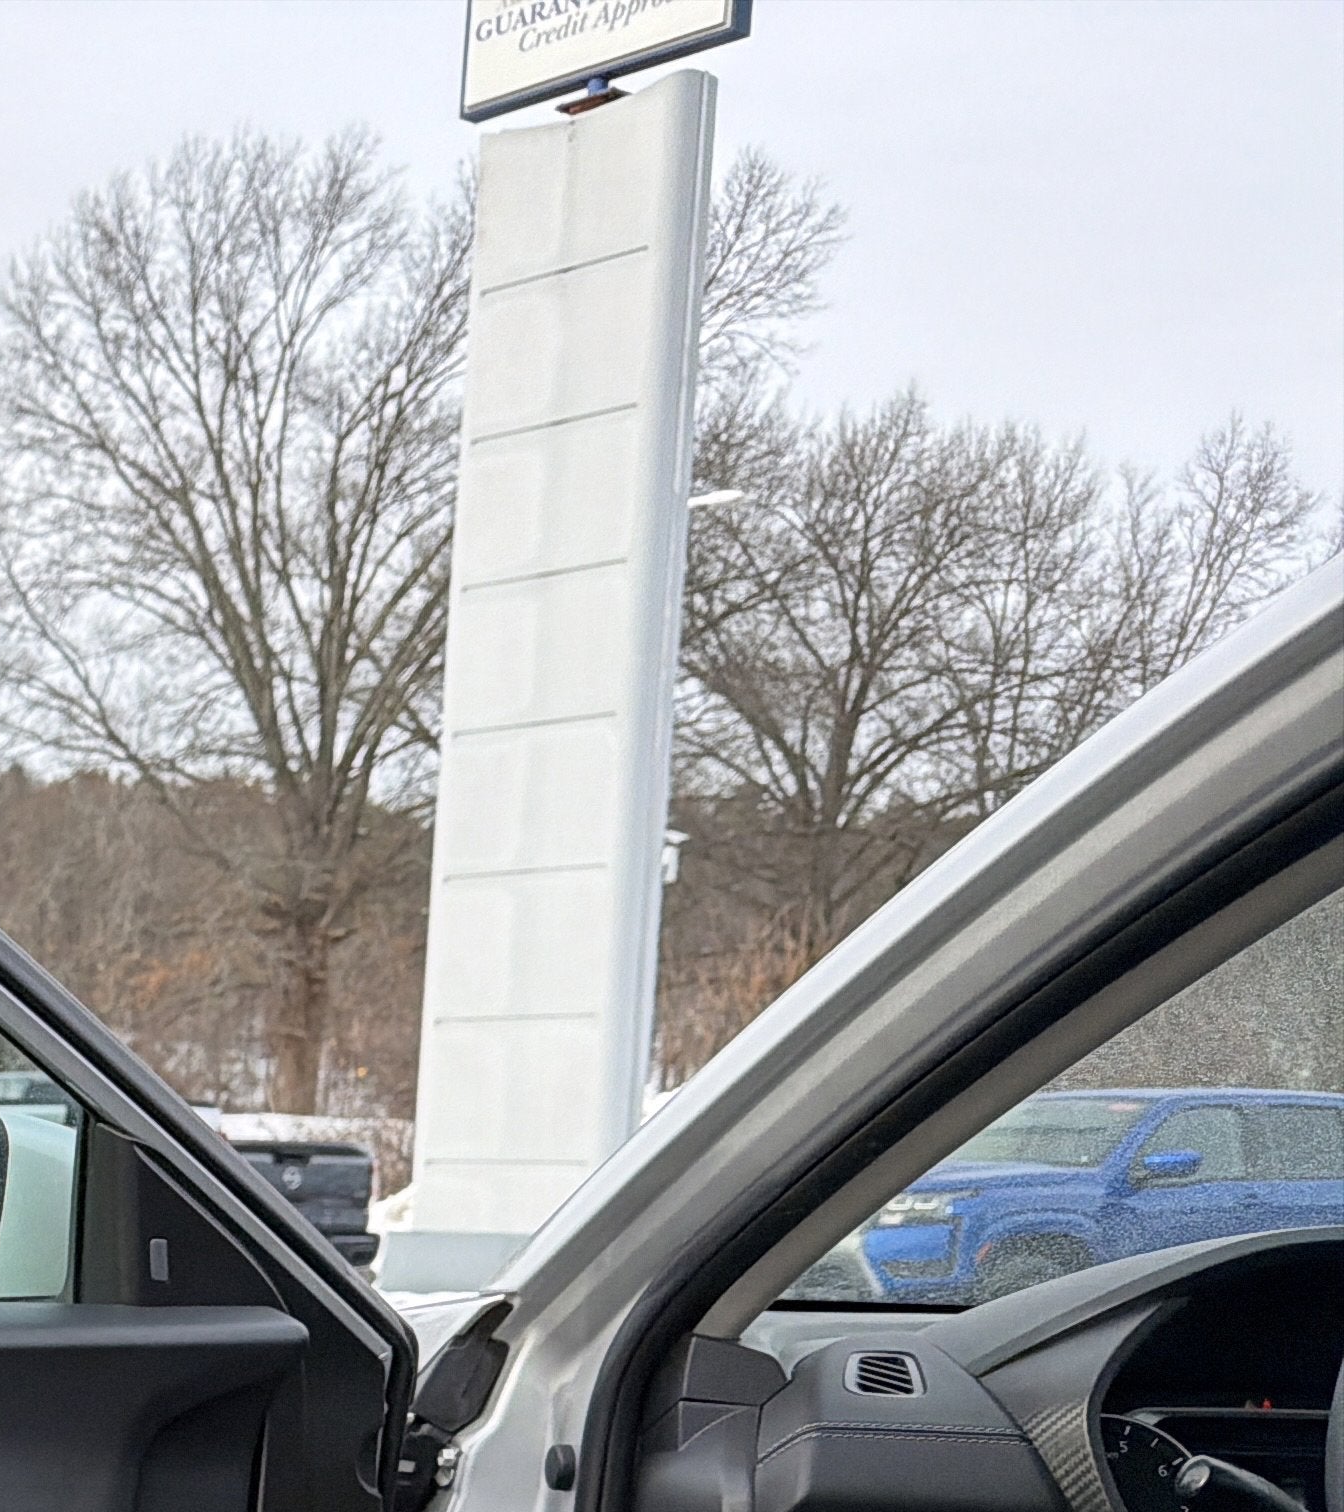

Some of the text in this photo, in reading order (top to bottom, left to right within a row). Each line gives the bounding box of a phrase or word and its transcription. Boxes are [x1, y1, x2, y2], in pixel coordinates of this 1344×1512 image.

[518, 0, 673, 52] Credit Appro
[1119, 1440, 1129, 1453] 5
[1158, 1464, 1169, 1477] 6
